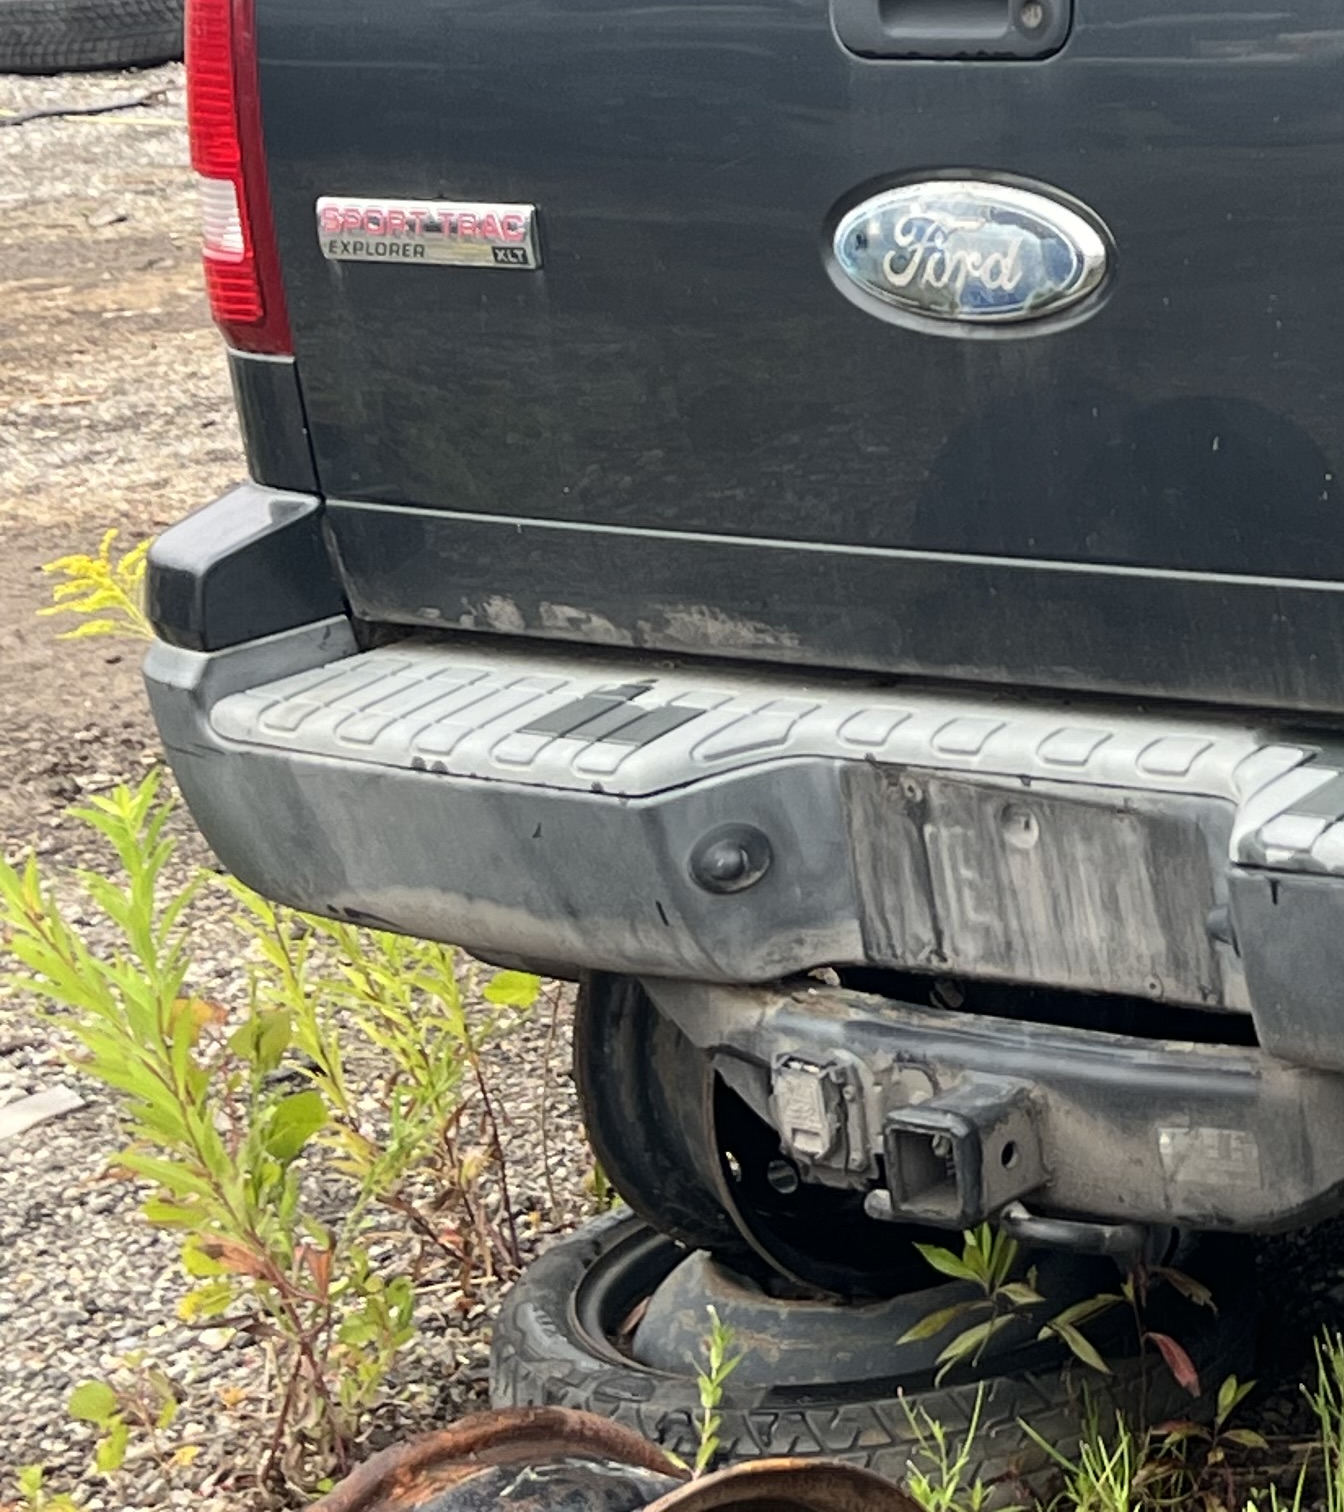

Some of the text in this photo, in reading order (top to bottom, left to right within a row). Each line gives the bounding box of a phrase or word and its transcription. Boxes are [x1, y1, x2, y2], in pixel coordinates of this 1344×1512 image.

[320, 204, 526, 243] SPORT TRAC
[328, 240, 526, 263] EXPLORER XLT
[882, 210, 1024, 291] Ford
